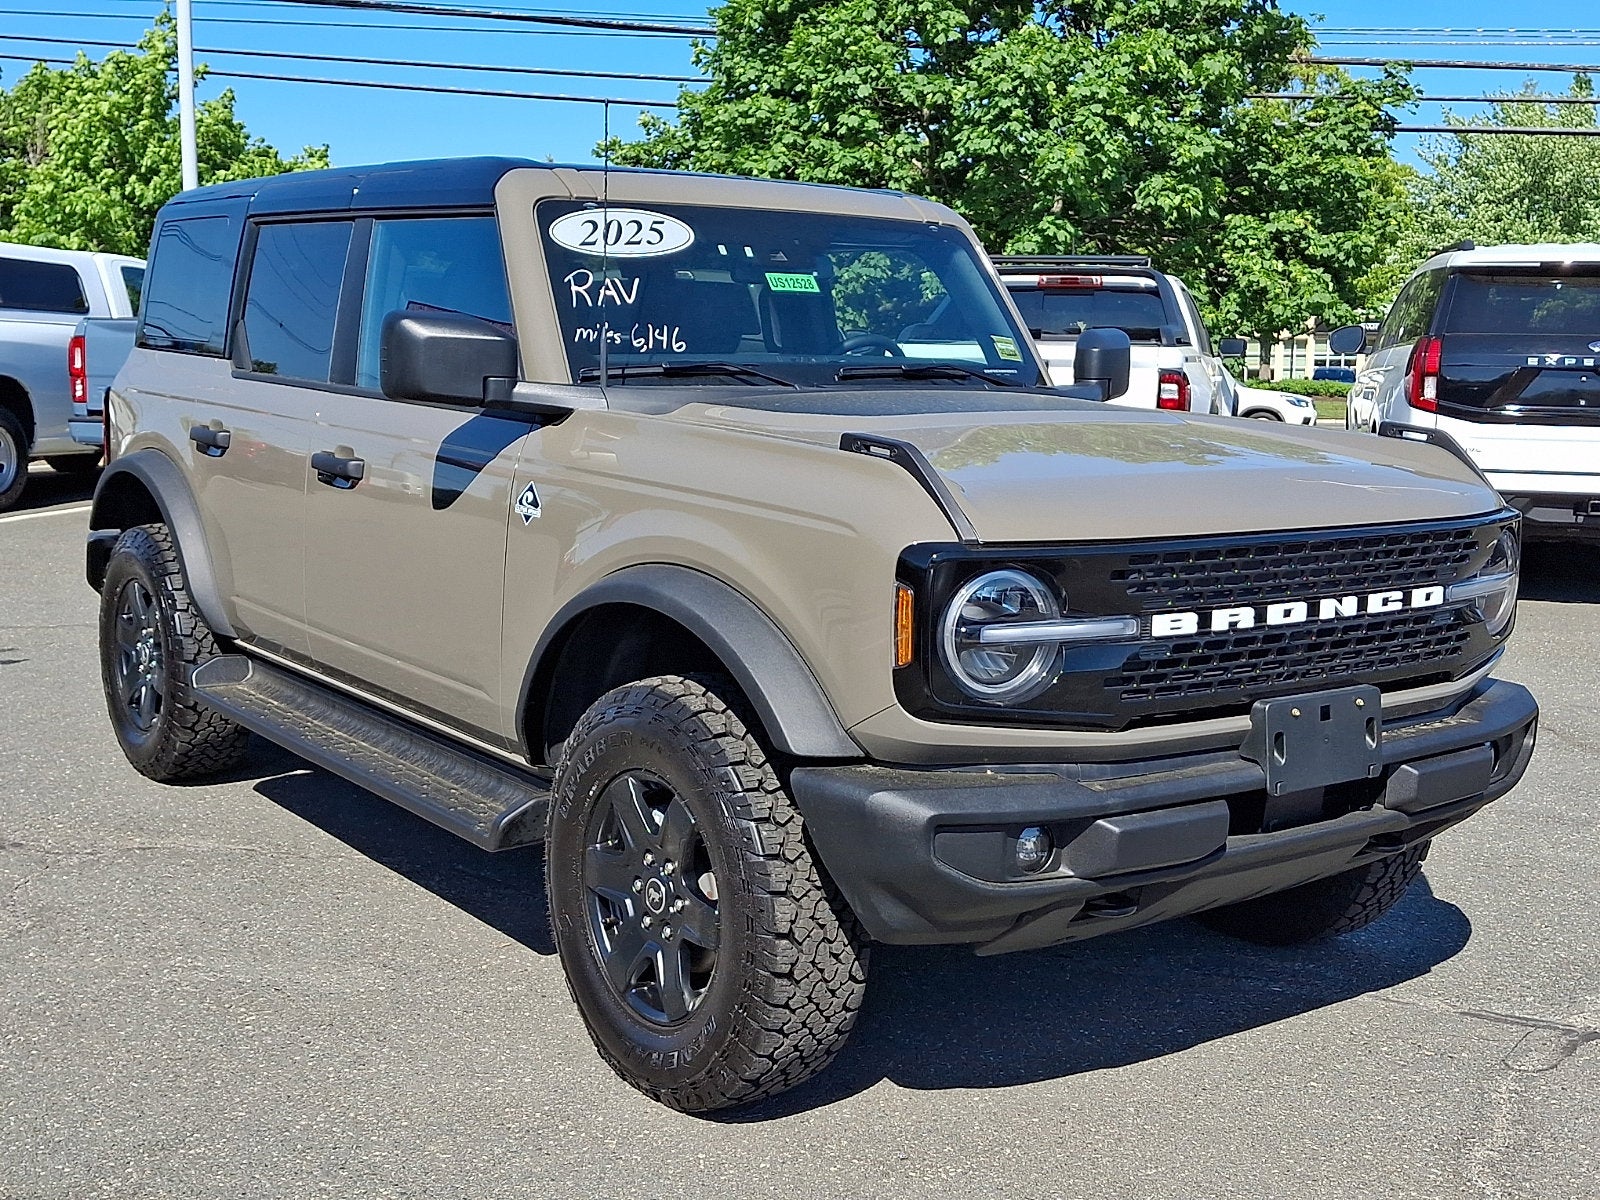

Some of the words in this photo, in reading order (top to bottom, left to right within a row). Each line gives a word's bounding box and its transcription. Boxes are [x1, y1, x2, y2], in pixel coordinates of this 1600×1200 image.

[579, 219, 665, 246] 2025
[564, 269, 640, 308] RAV
[769, 276, 814, 289] US12528
[631, 322, 687, 353] 6,146
[1527, 355, 1595, 367] EXPE
[1151, 585, 1444, 637] BRONCO
